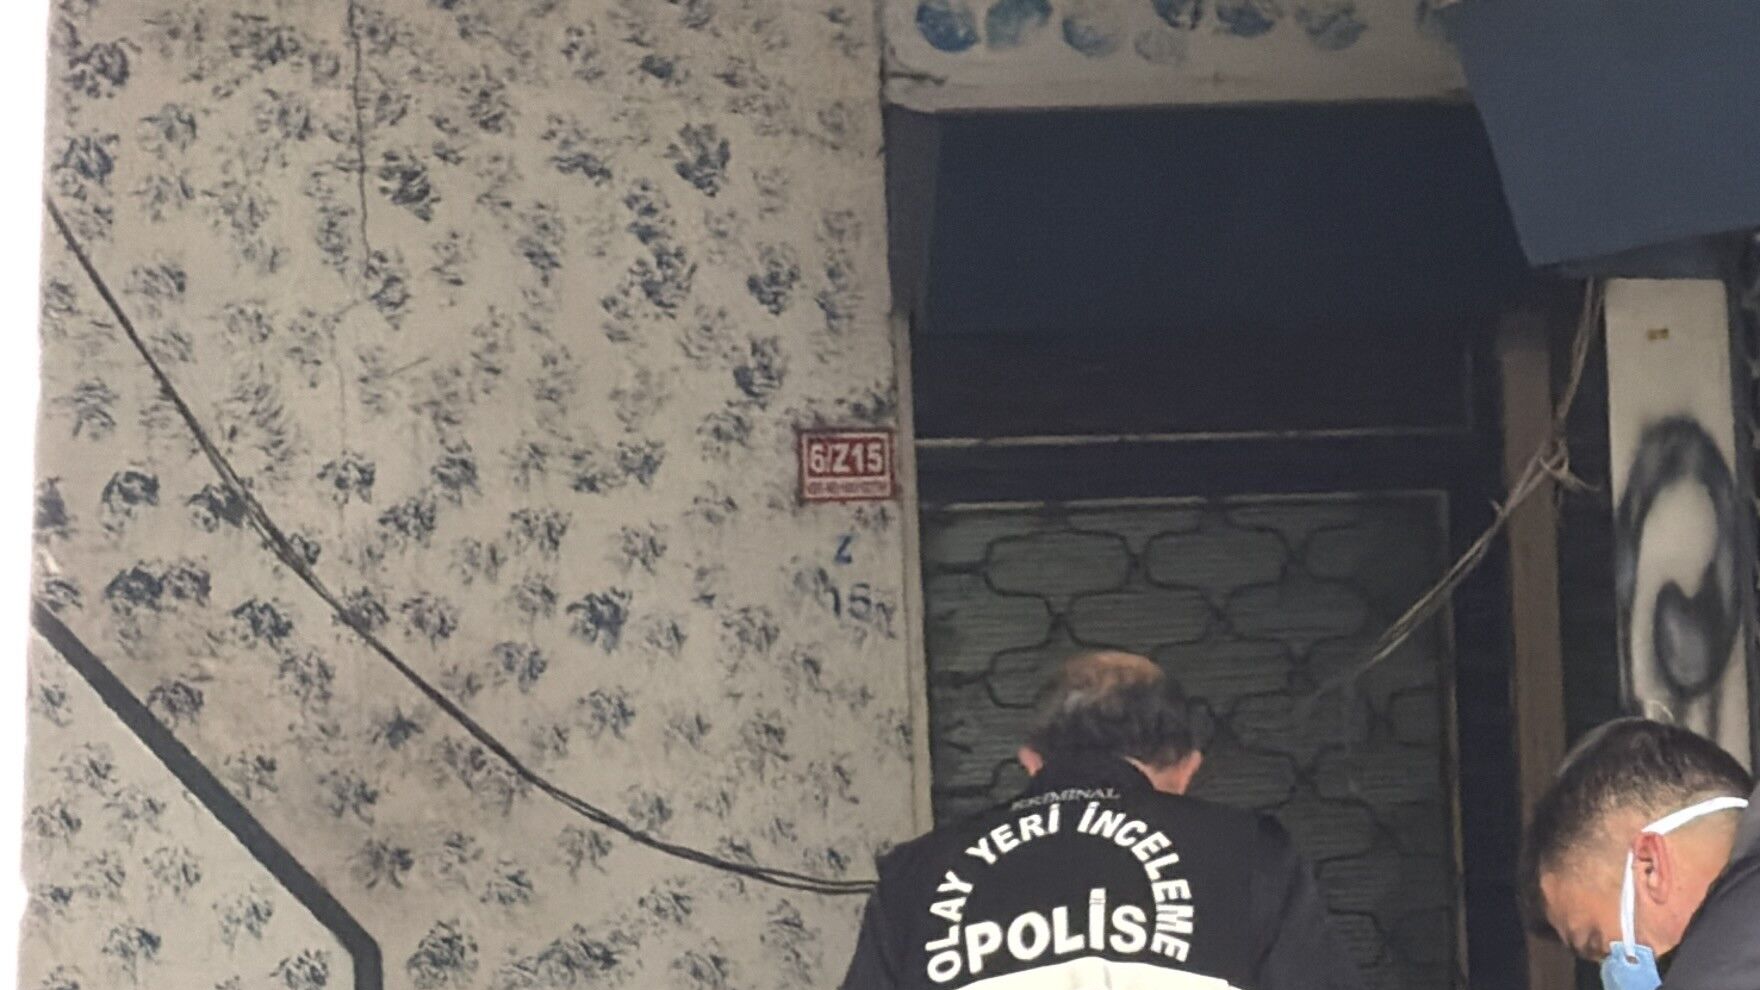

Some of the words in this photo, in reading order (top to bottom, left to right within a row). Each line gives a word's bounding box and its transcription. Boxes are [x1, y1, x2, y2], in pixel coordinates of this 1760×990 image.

[925, 870, 974, 983] OLAY
[965, 803, 1060, 866] YERİ
[1076, 801, 1195, 963] İNCELEME
[964, 887, 1148, 974] POLİS
